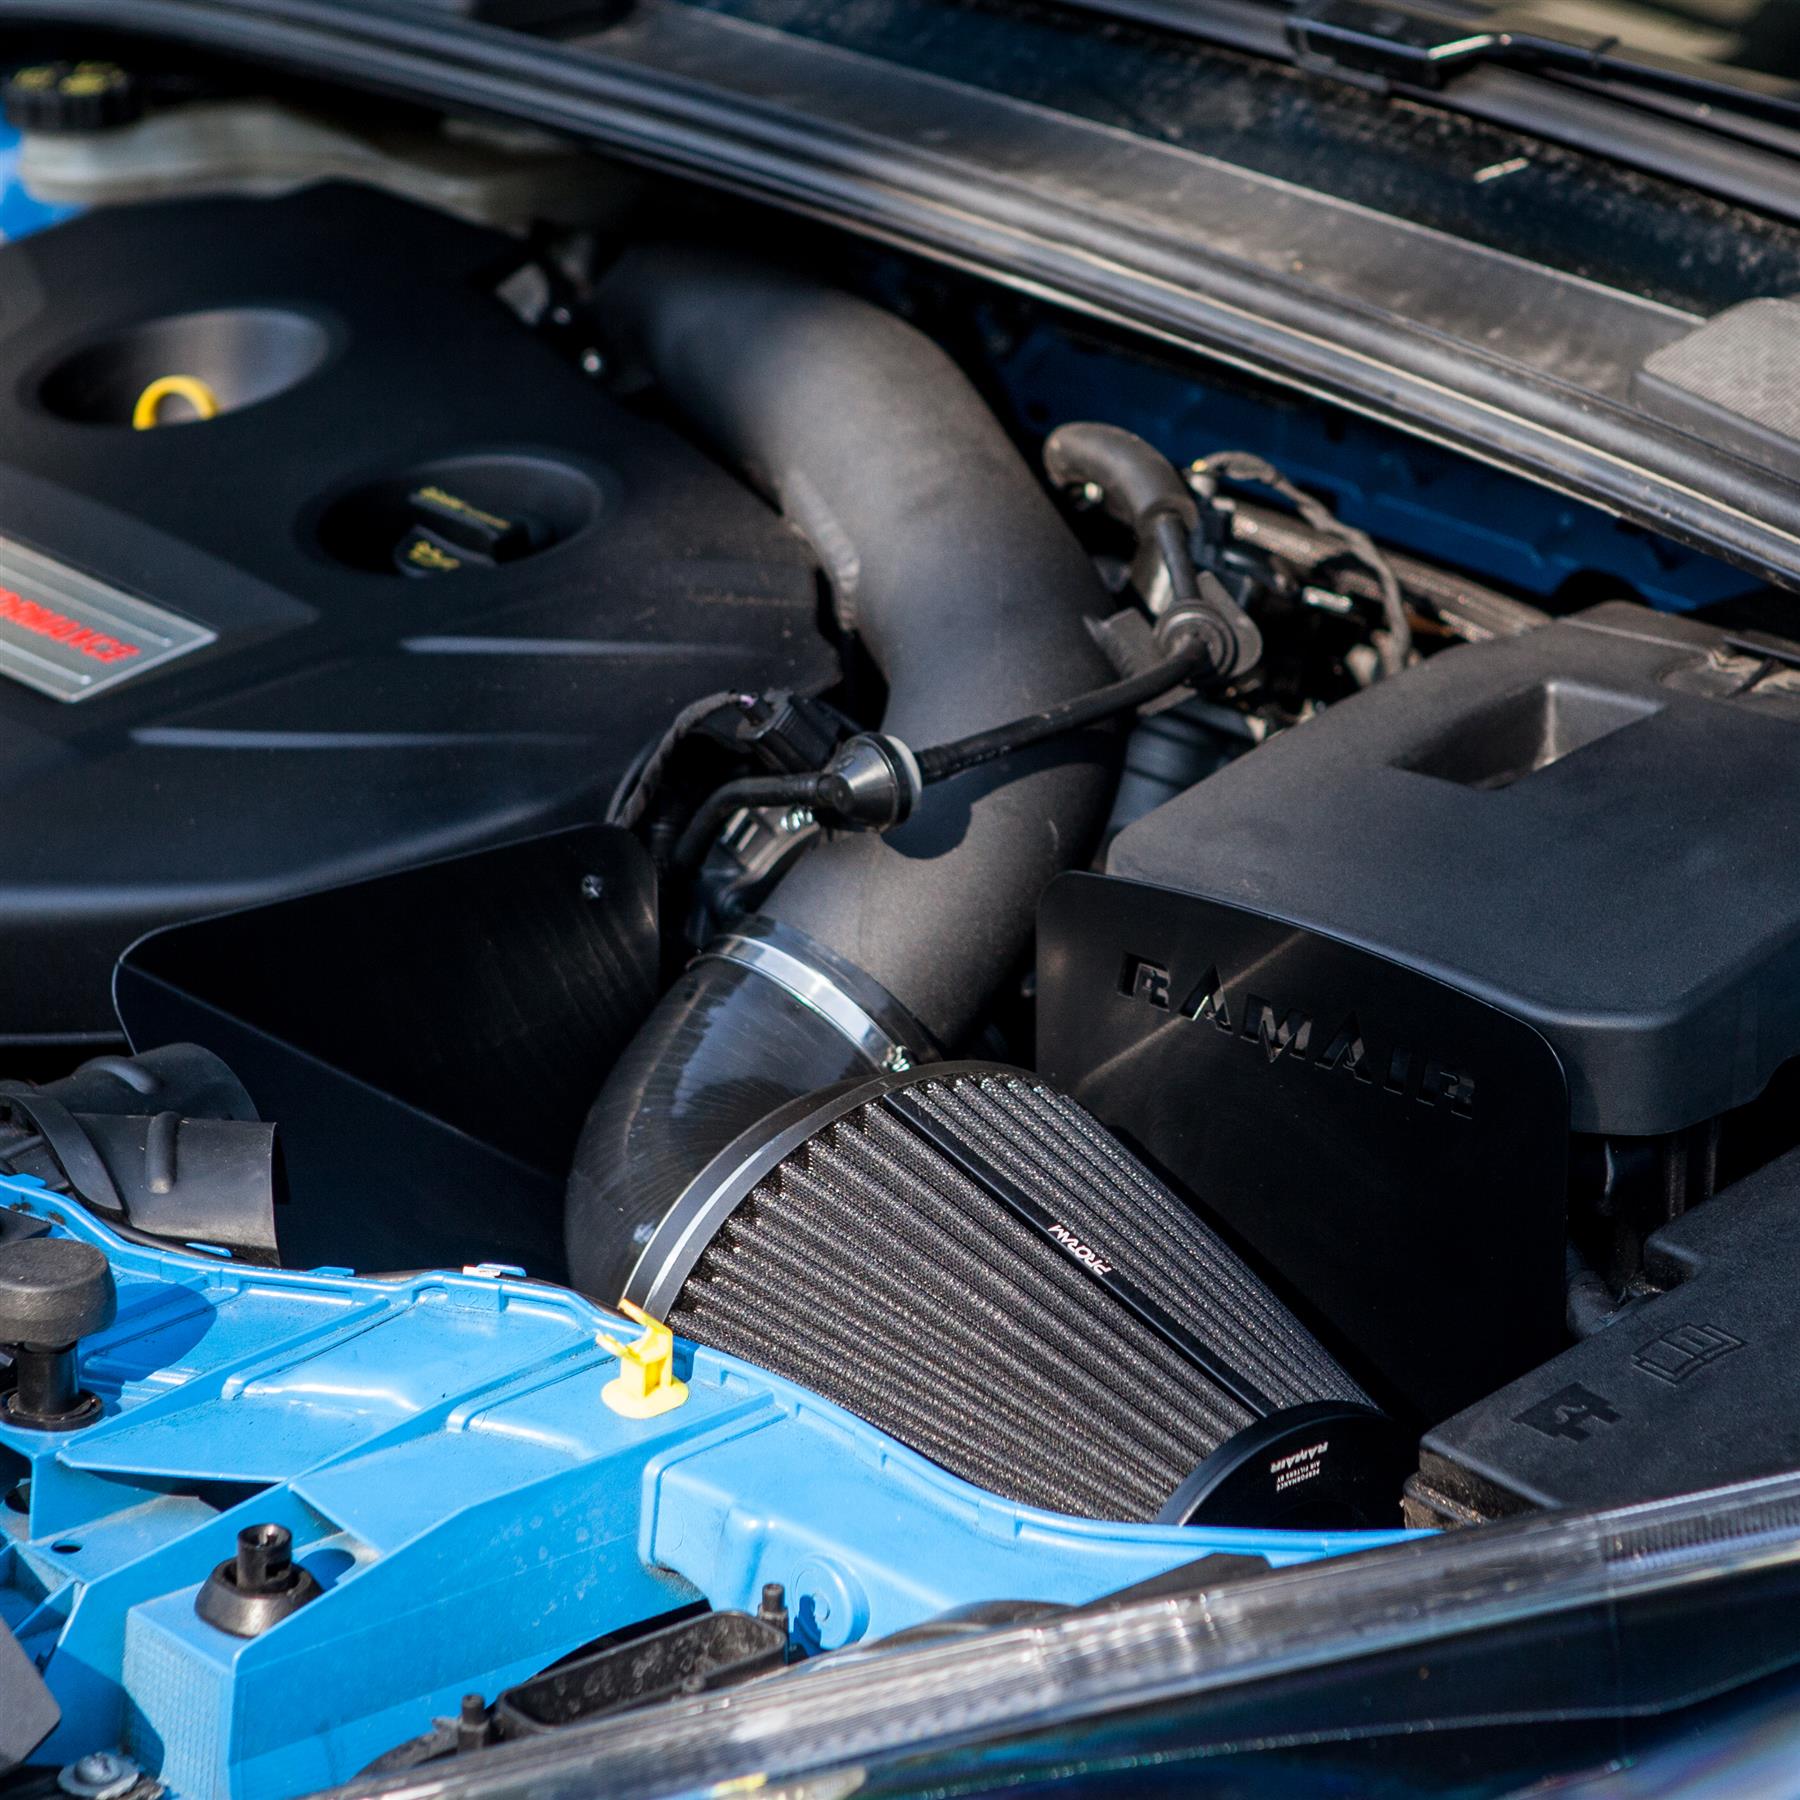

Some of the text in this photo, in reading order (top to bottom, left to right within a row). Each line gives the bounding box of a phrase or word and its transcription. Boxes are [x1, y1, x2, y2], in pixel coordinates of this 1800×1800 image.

[1117, 952, 1476, 1119] RAMAIR
[1047, 1224, 1112, 1276] PRORAM
[1270, 1441, 1328, 1473] RAMAIR
[1310, 1460, 1320, 1470] AIR
[1276, 1468, 1320, 1492] PERFORMANCE
[1285, 1465, 1309, 1479] FILTERS
